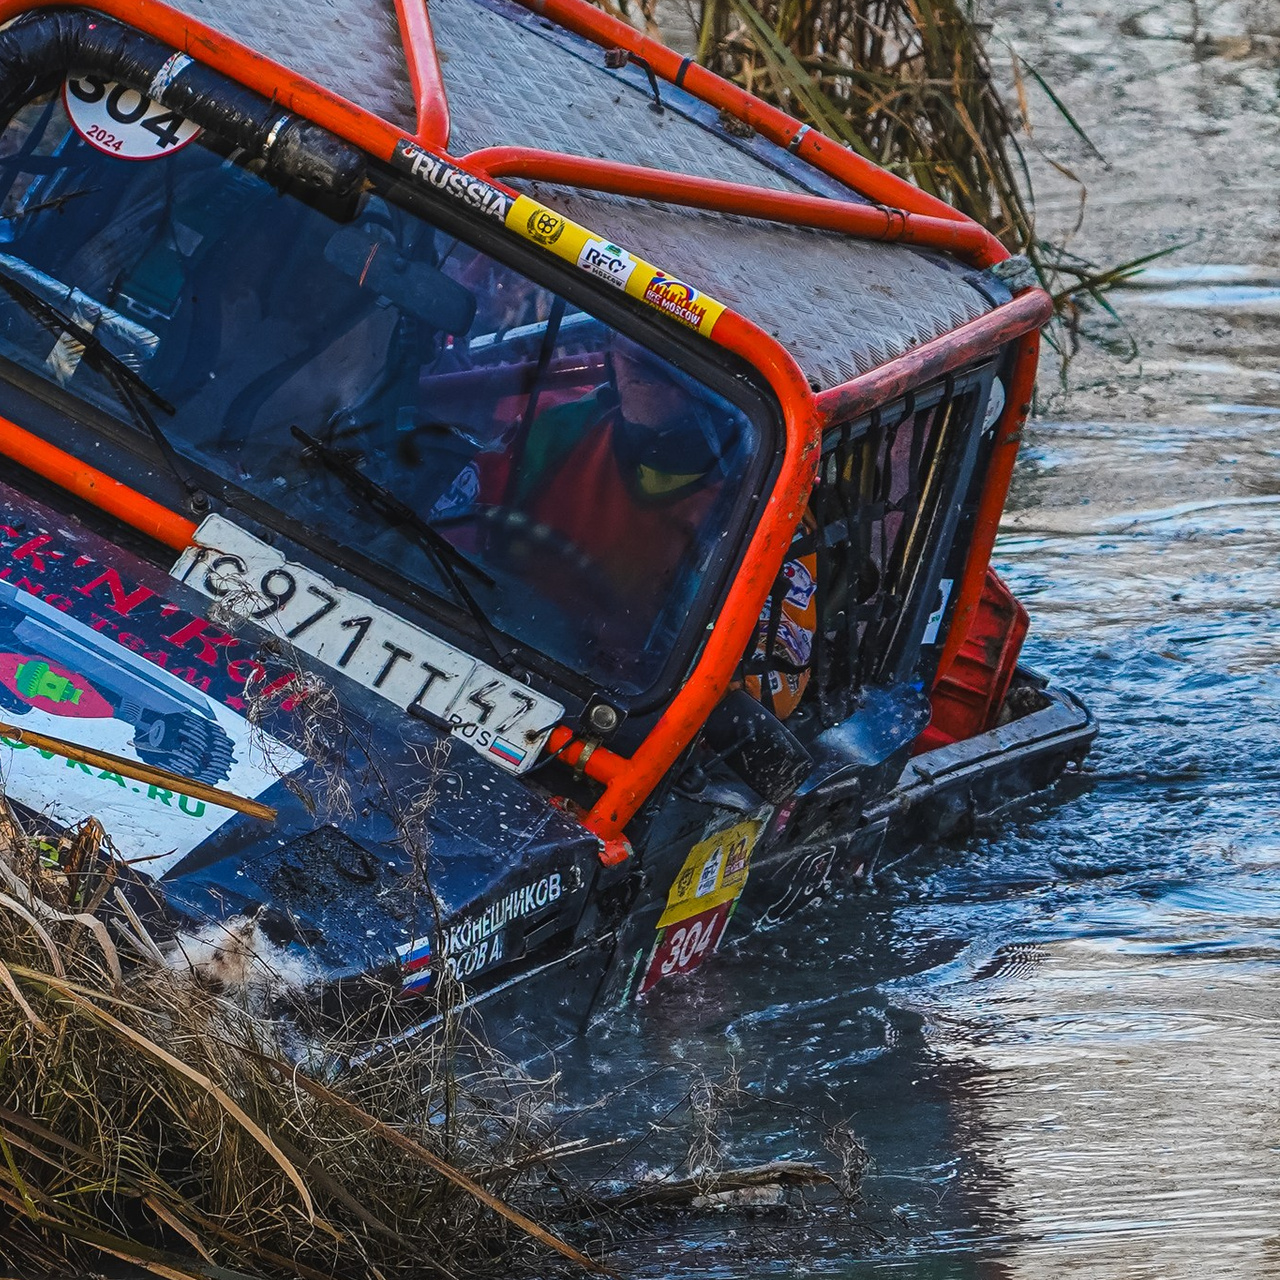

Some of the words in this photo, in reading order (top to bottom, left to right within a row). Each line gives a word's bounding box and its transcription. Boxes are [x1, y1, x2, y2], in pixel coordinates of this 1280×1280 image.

[85, 123, 125, 151] 2024
[410, 151, 506, 223] RUSSIA
[661, 297, 701, 325] MOSCOW
[467, 680, 537, 735] 47
[449, 713, 492, 748] RUS
[661, 912, 720, 974] 304
